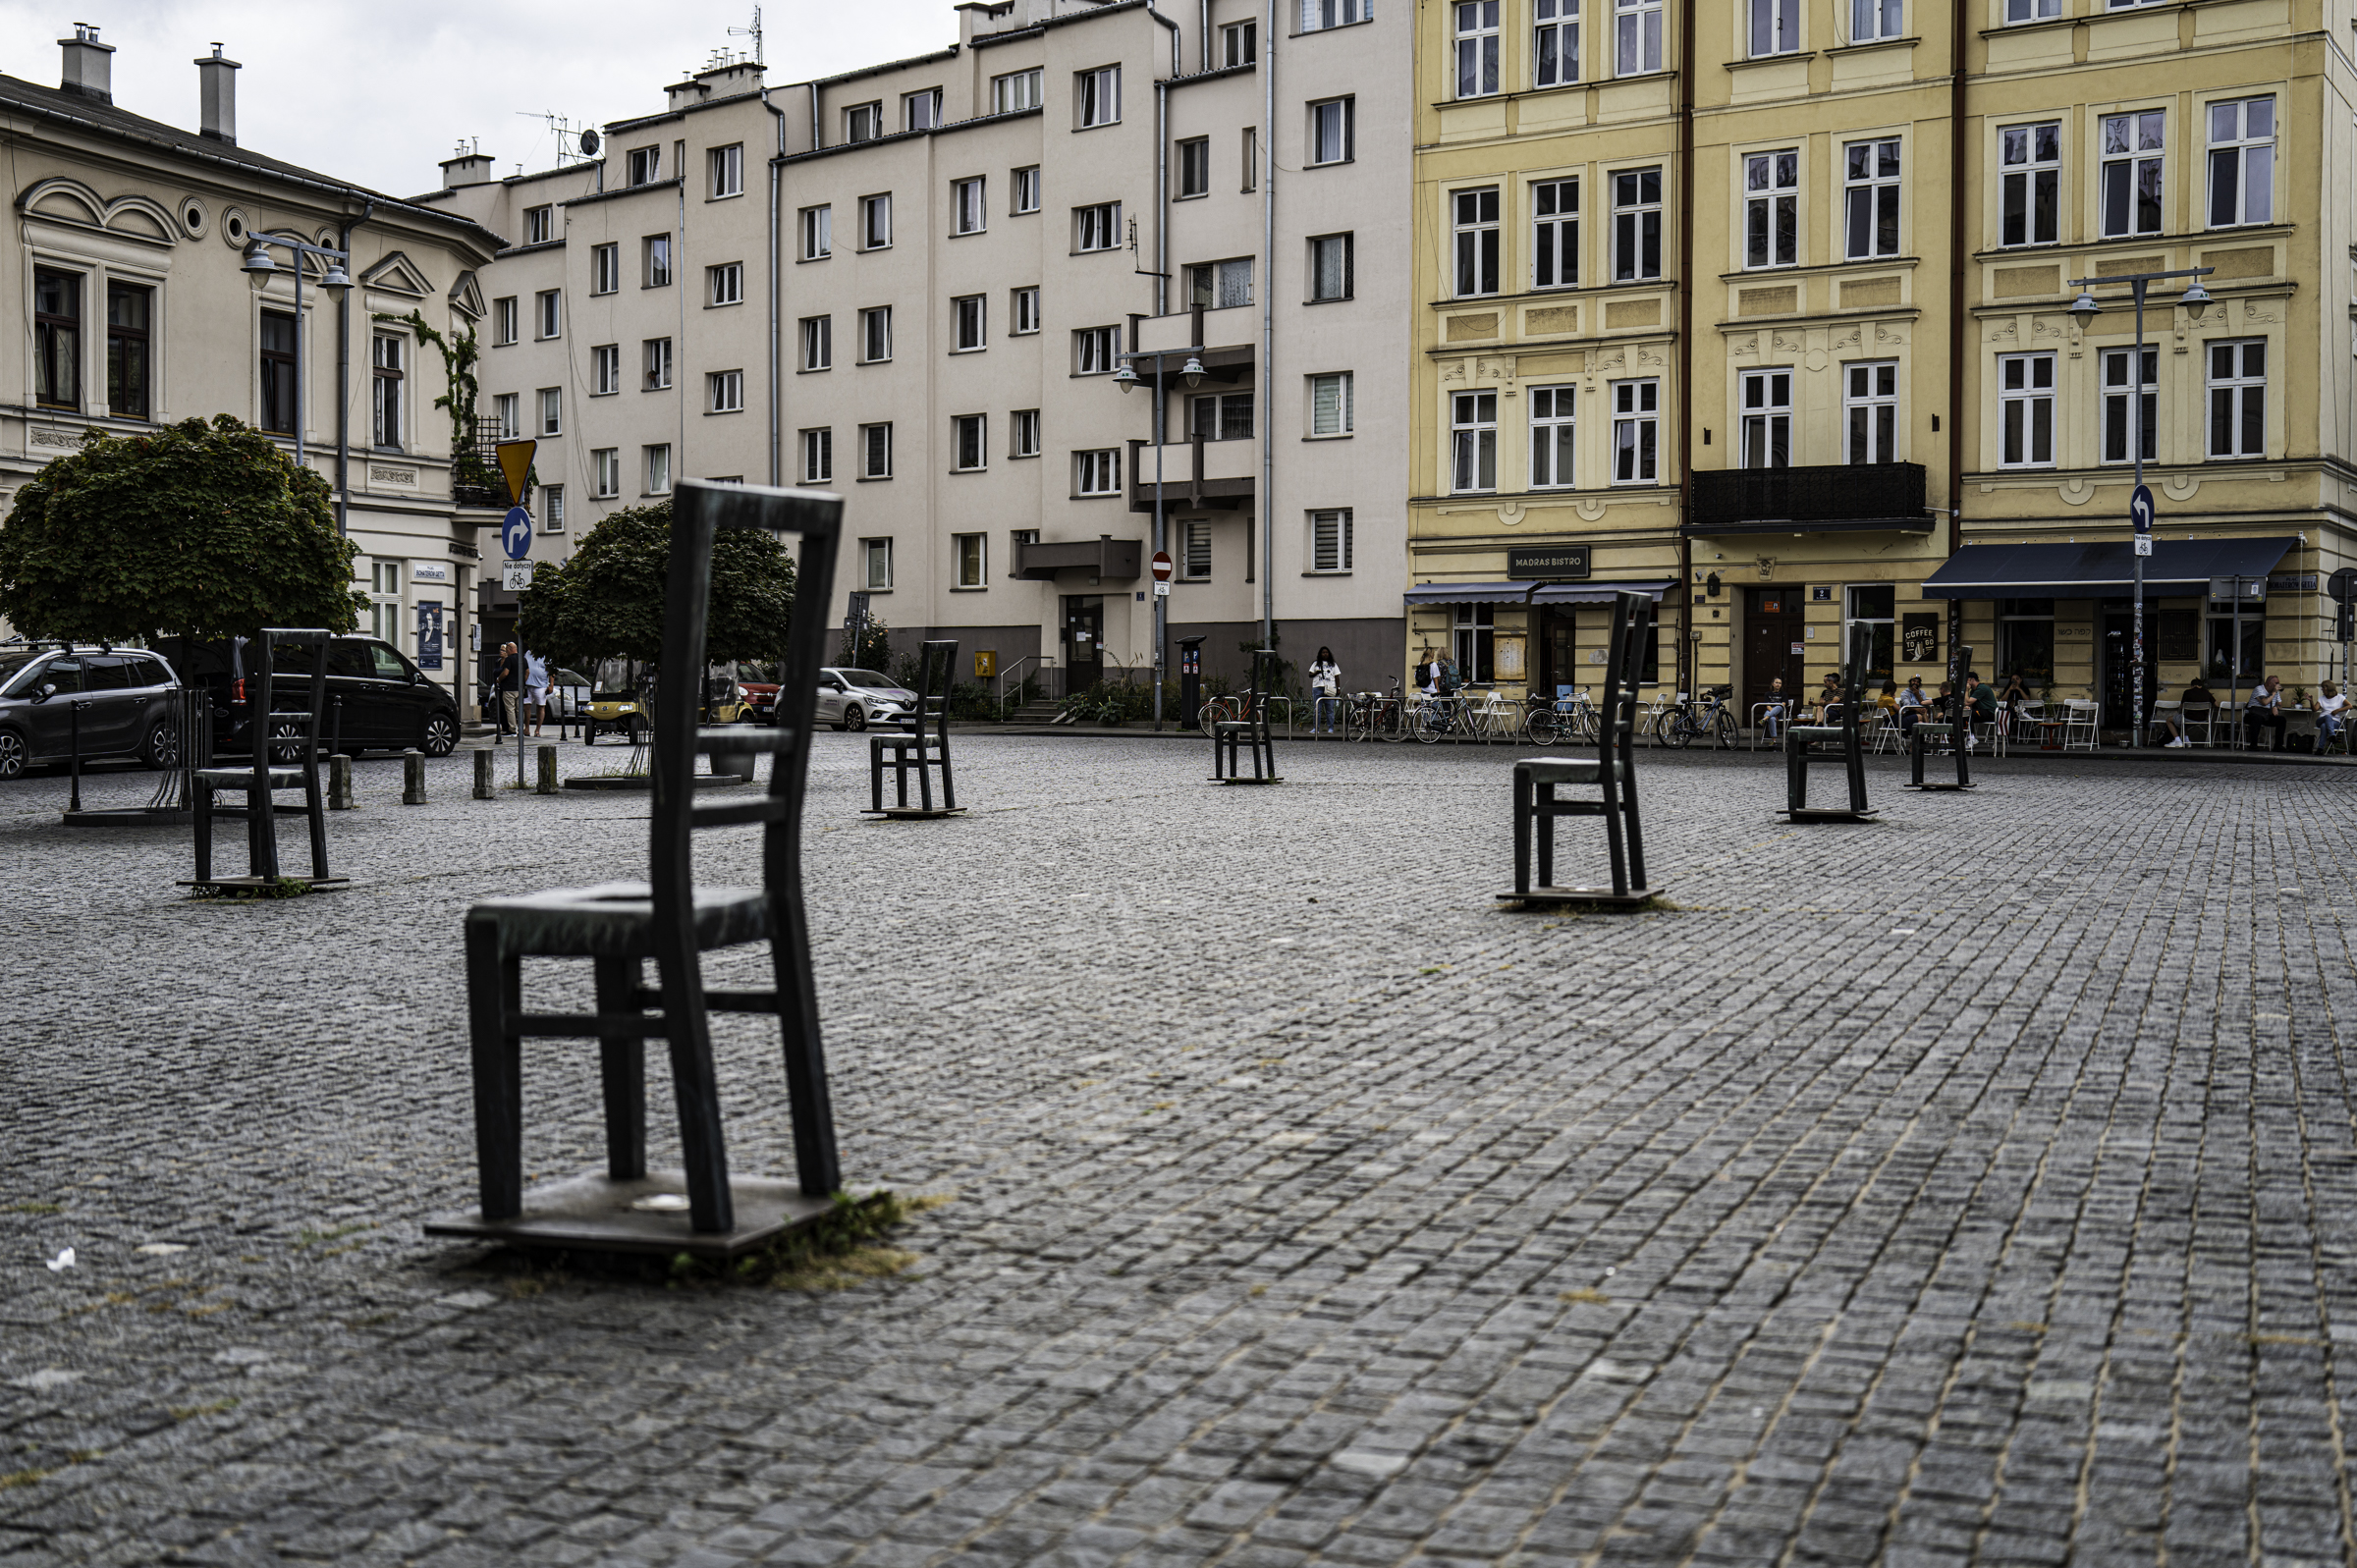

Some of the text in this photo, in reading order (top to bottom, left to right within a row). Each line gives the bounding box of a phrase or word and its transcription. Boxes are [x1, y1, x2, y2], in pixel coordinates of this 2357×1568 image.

[514, 562, 531, 570] dotyczy
[1516, 557, 1581, 567] MADRAS BISTRO
[1905, 629, 1933, 639] COFFEE
[1194, 651, 1197, 659] P
